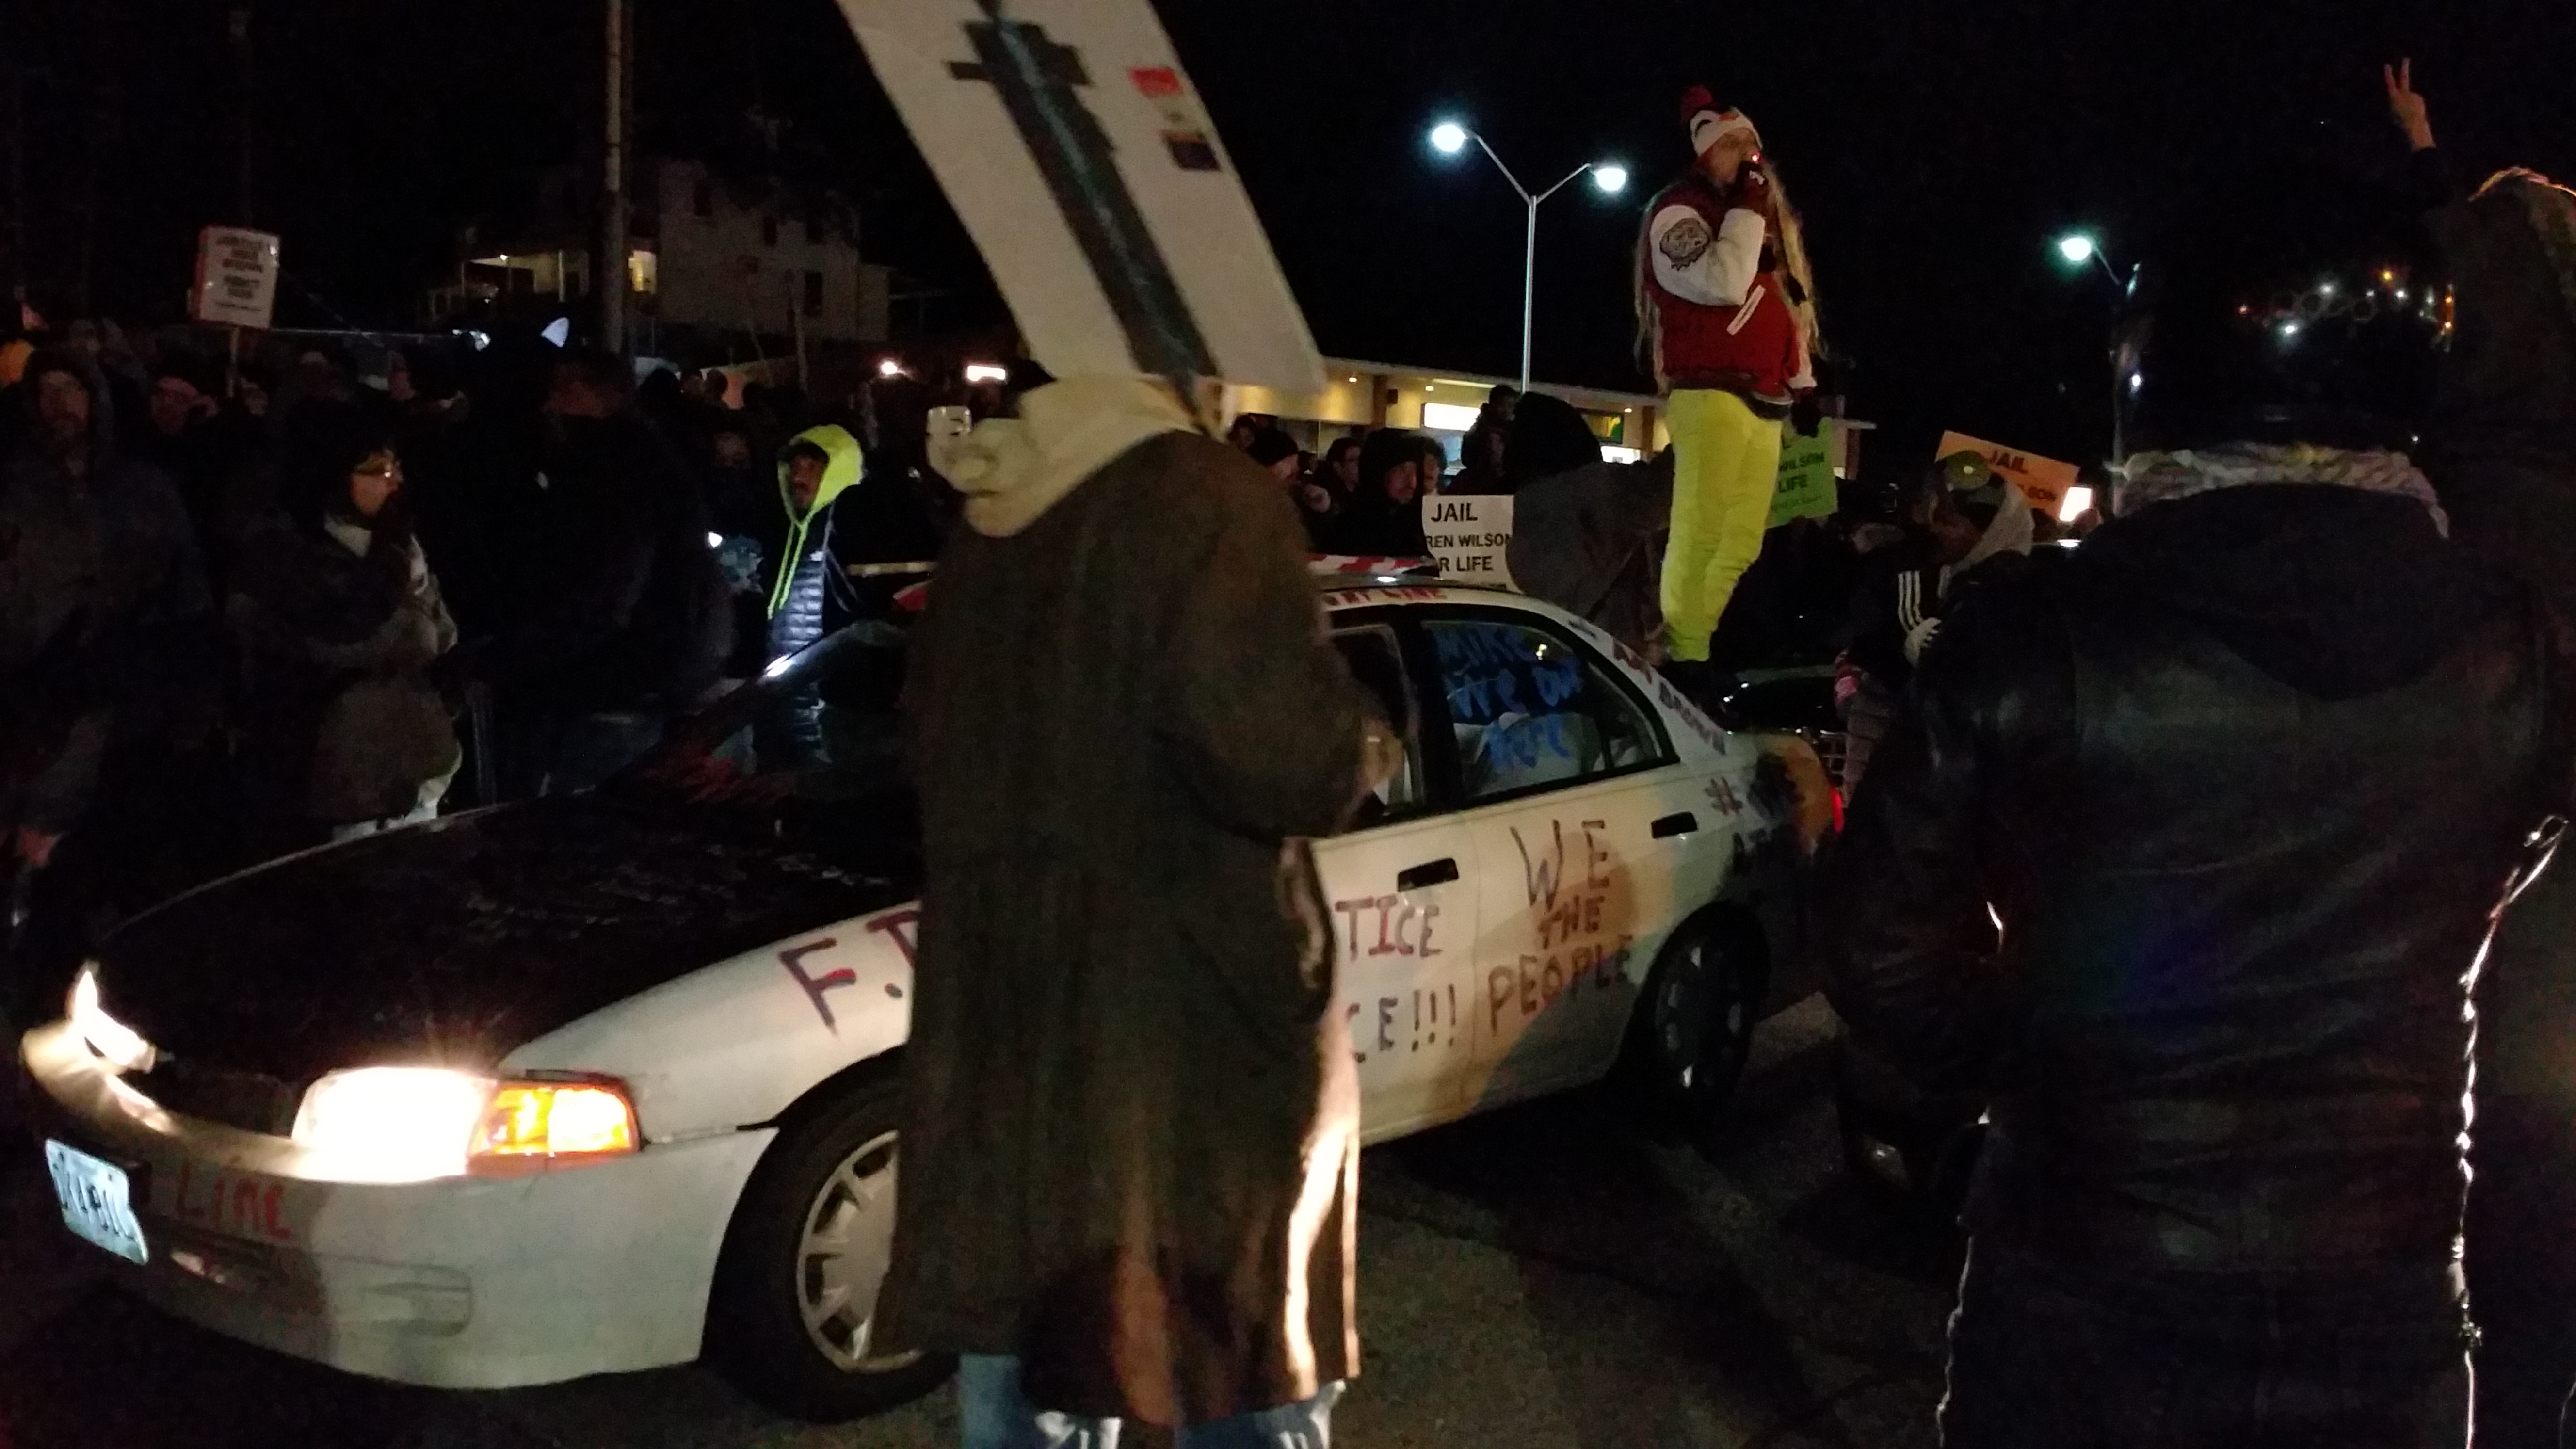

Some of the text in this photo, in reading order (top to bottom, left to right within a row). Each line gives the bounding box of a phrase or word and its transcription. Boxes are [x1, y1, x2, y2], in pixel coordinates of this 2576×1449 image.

[1988, 450, 2028, 475] JAIL
[1431, 502, 1478, 522] JAIL
[1459, 533, 1509, 547] WILSO
[1456, 556, 1493, 572] LIFE
[1509, 819, 1610, 911] WE
[1335, 894, 1443, 963] TICE
[1538, 895, 1605, 950] THE
[1487, 934, 1633, 1037] PEOPLE
